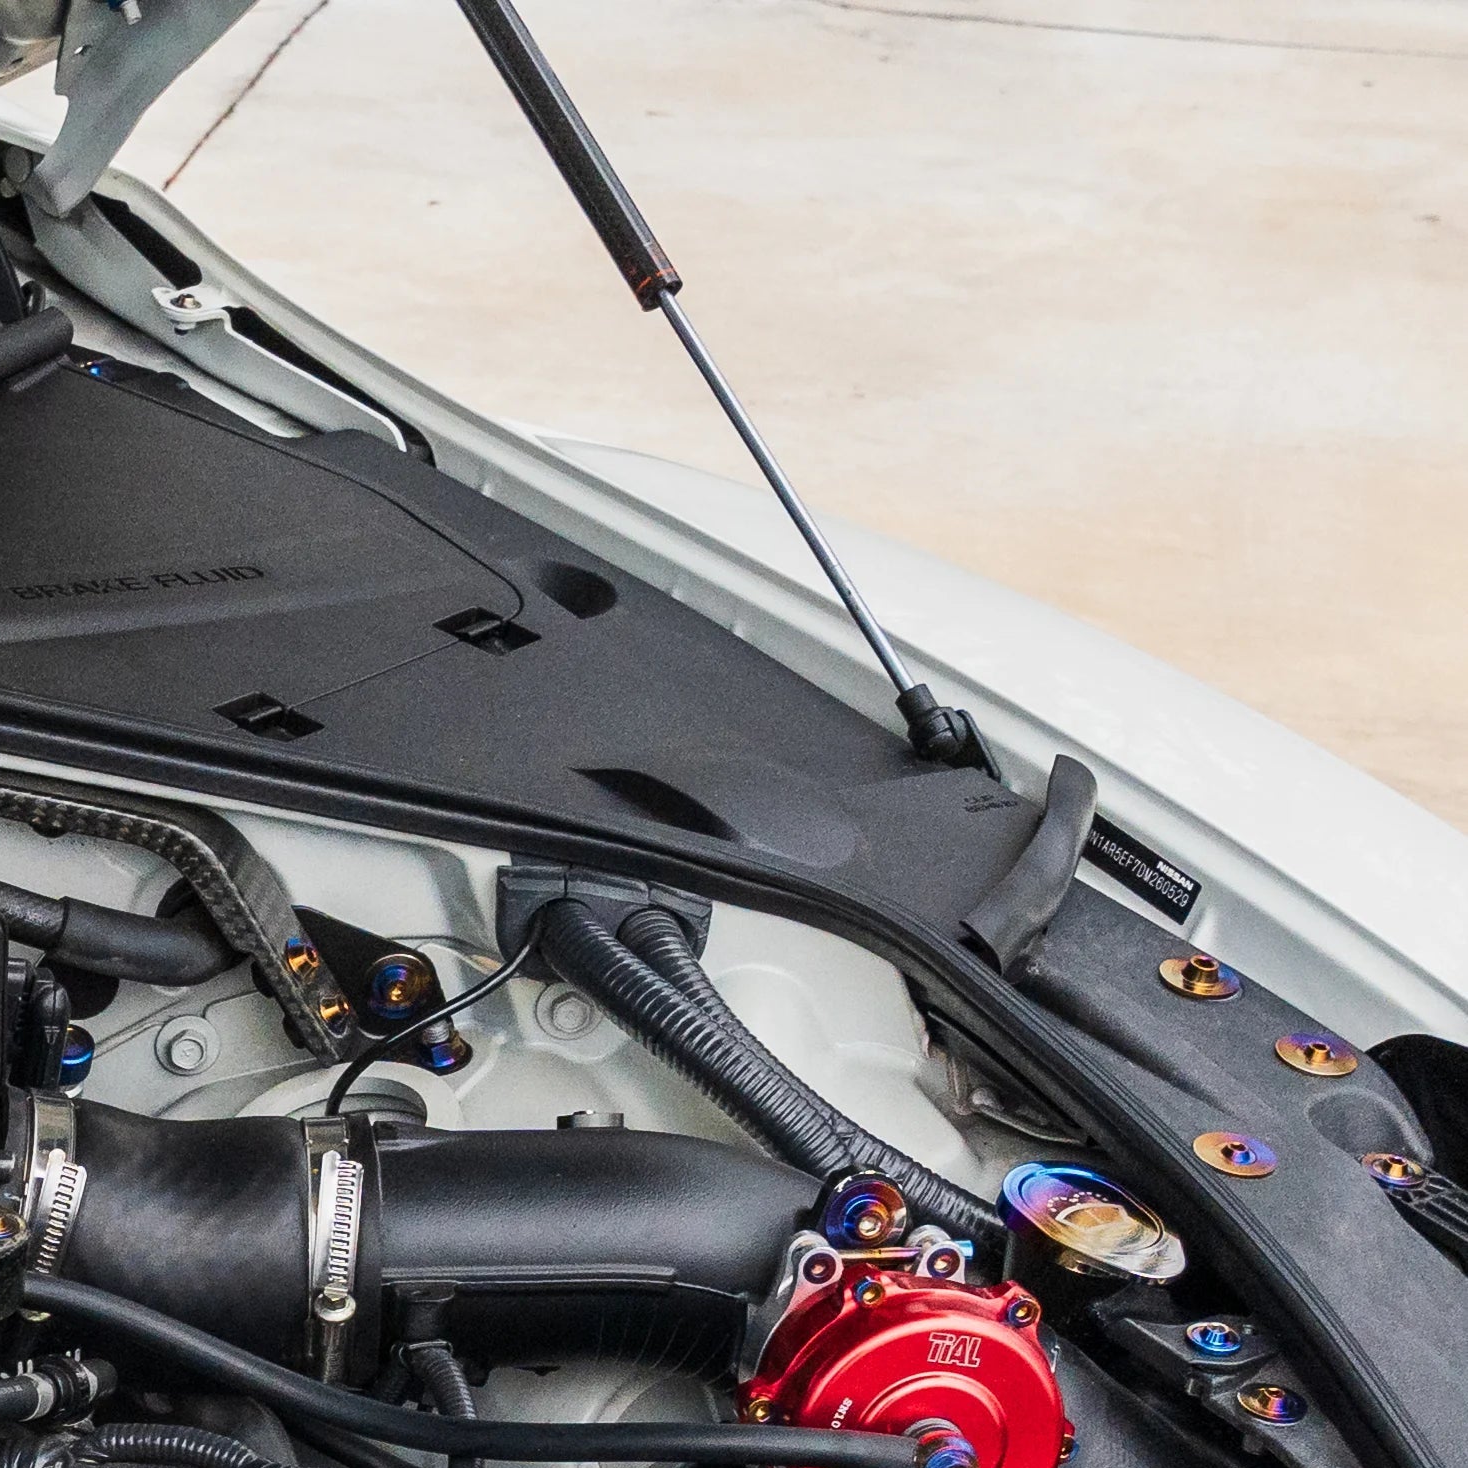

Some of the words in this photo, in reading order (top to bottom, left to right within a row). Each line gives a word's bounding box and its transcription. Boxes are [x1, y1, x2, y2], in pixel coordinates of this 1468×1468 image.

[8, 576, 149, 600] BRAKE
[152, 565, 264, 588] FLUID
[1156, 860, 1194, 891] NISSAN
